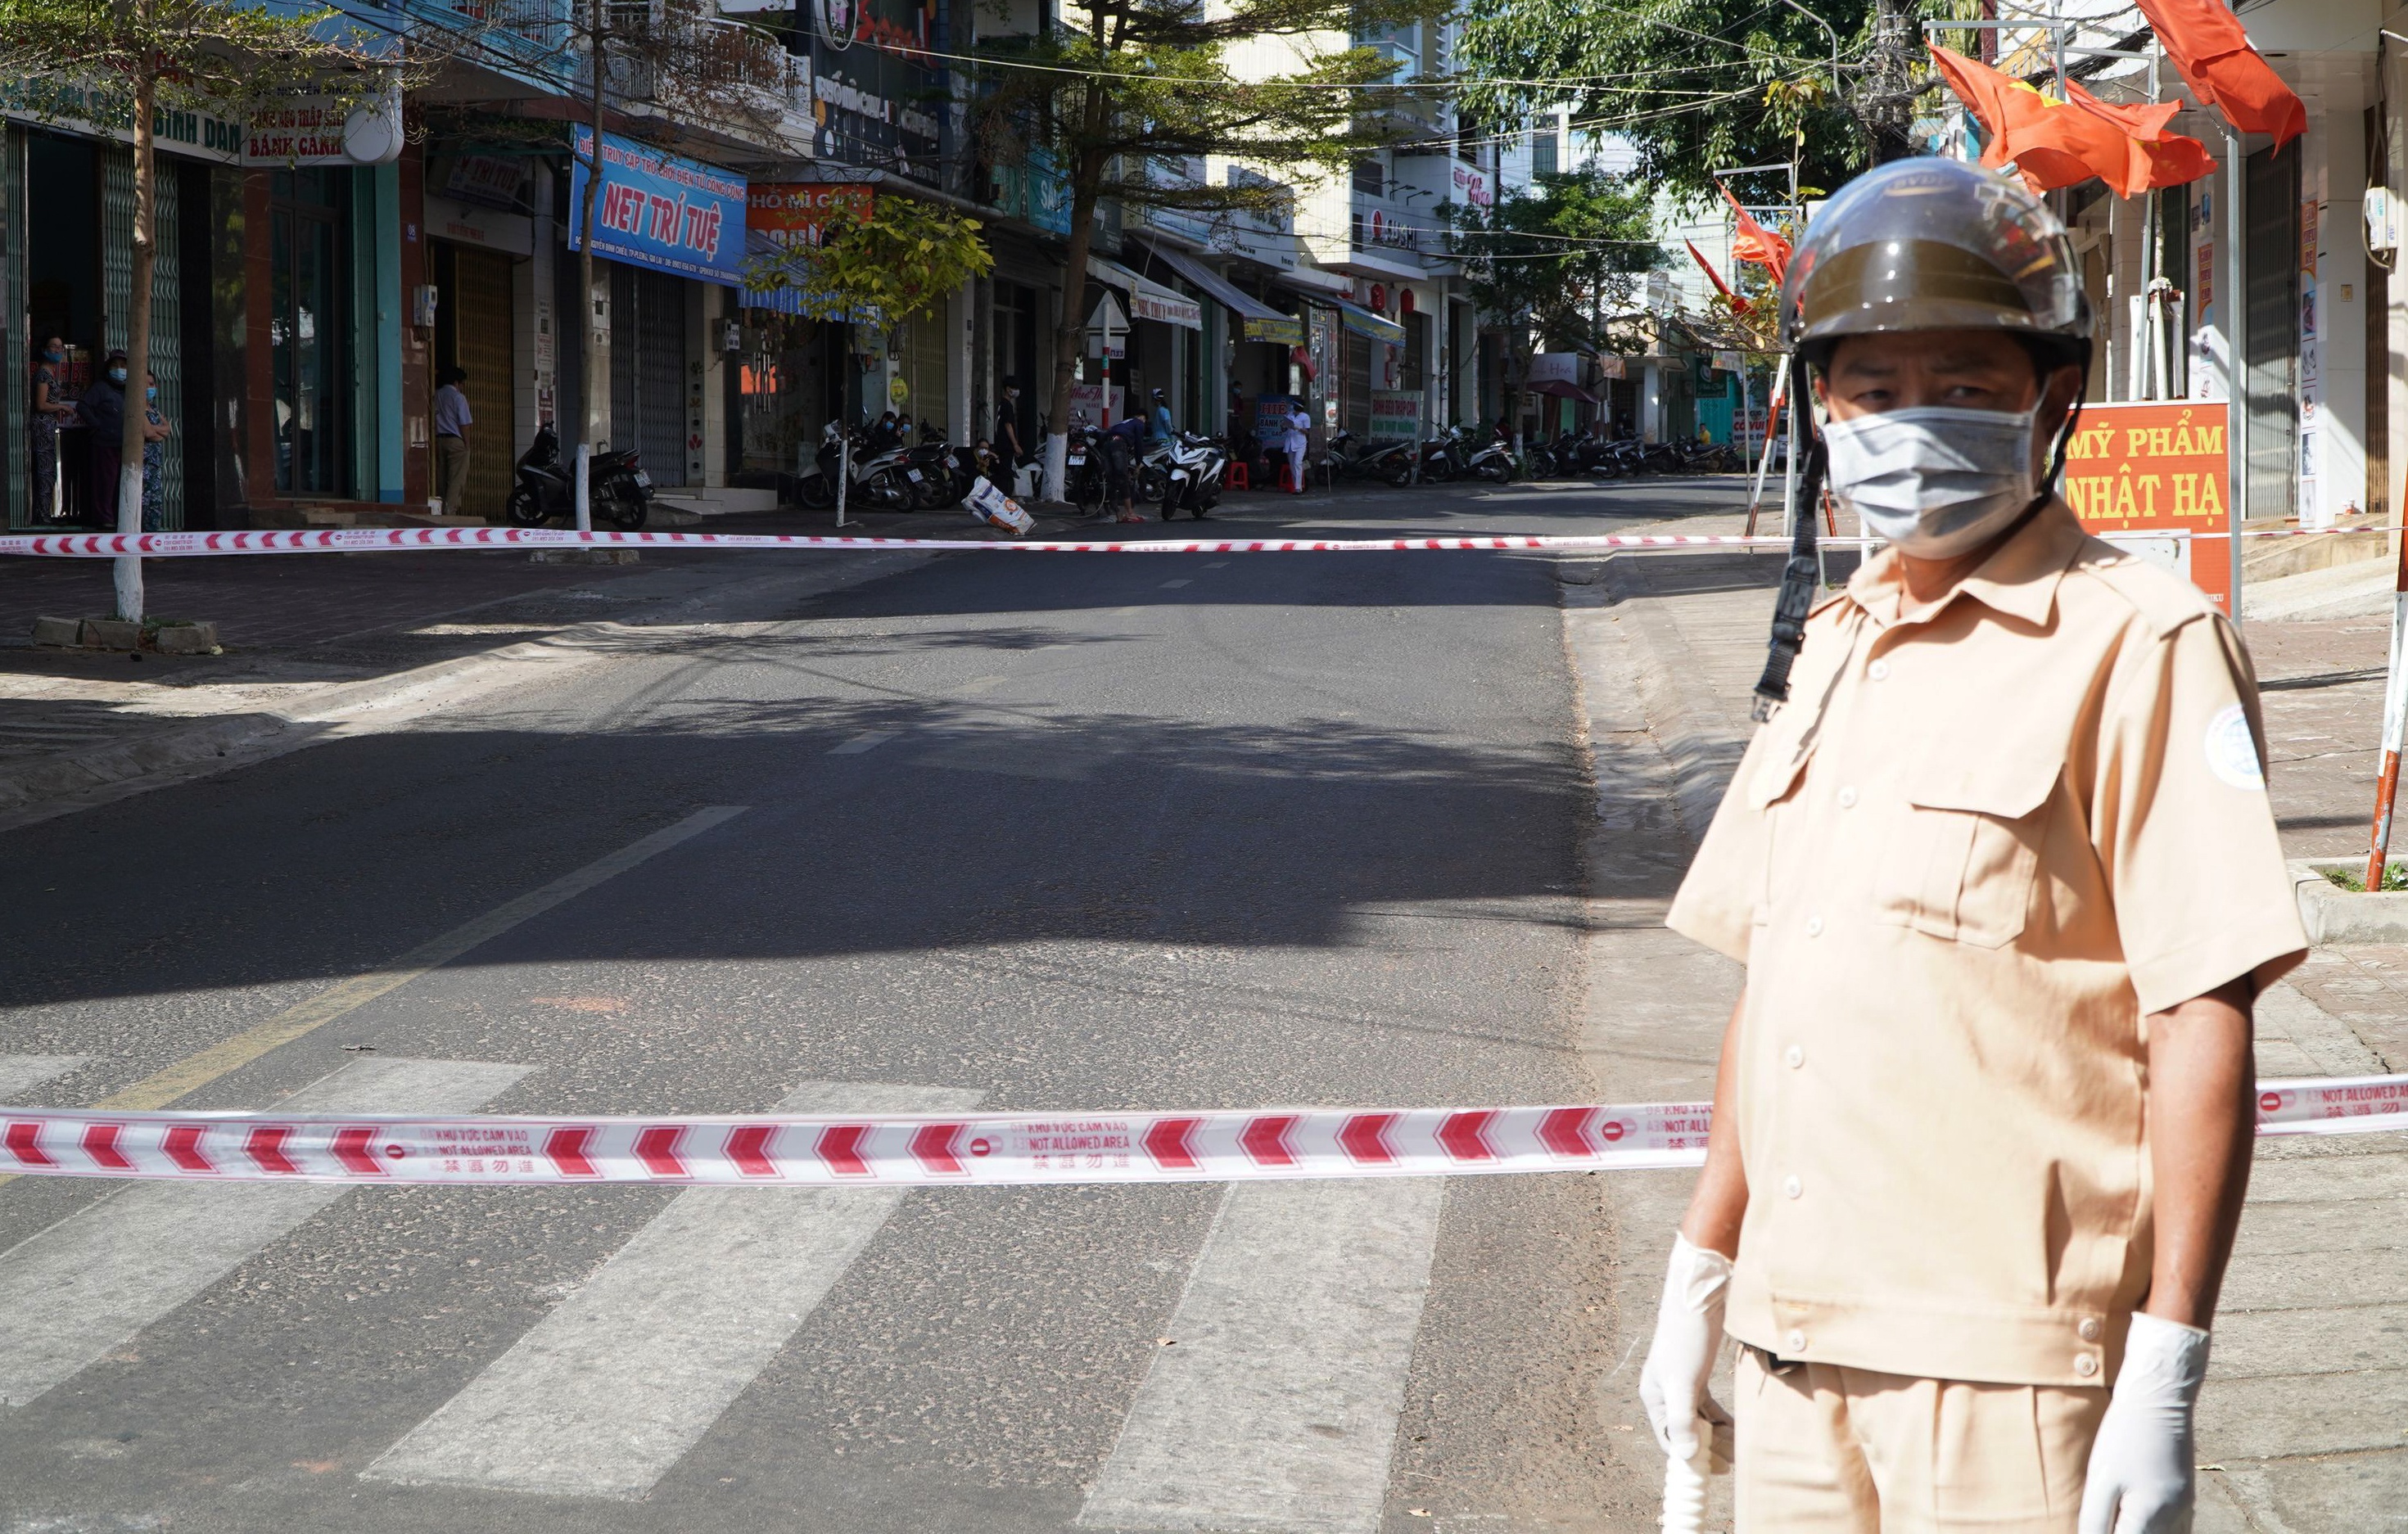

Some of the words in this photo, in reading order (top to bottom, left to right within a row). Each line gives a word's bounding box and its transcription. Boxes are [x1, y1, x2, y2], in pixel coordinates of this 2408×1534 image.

[603, 145, 623, 162] TRUY
[625, 150, 640, 171] CẬP
[676, 169, 694, 188] ĐIỆN
[707, 177, 726, 196] CÔNG
[603, 183, 646, 234] NET
[650, 192, 687, 246] TRÍ
[685, 202, 721, 262] TUỆ
[2066, 421, 2116, 460] MỸ
[2126, 408, 2224, 458] PHẨM
[2065, 462, 2162, 530] NHẬT
[2171, 472, 2225, 527] HẠ
[2322, 1090, 2342, 1102] NOT
[2346, 1086, 2397, 1100] ALLOWED
[1029, 1137, 1049, 1150] NOT
[1052, 1135, 1100, 1149] ALLOWED
[1103, 1135, 1130, 1148] AREA
[1665, 1120, 1686, 1133] NOT
[439, 1145, 458, 1156] NOT
[460, 1145, 505, 1156] ALLOWED
[507, 1145, 532, 1155] AREA
